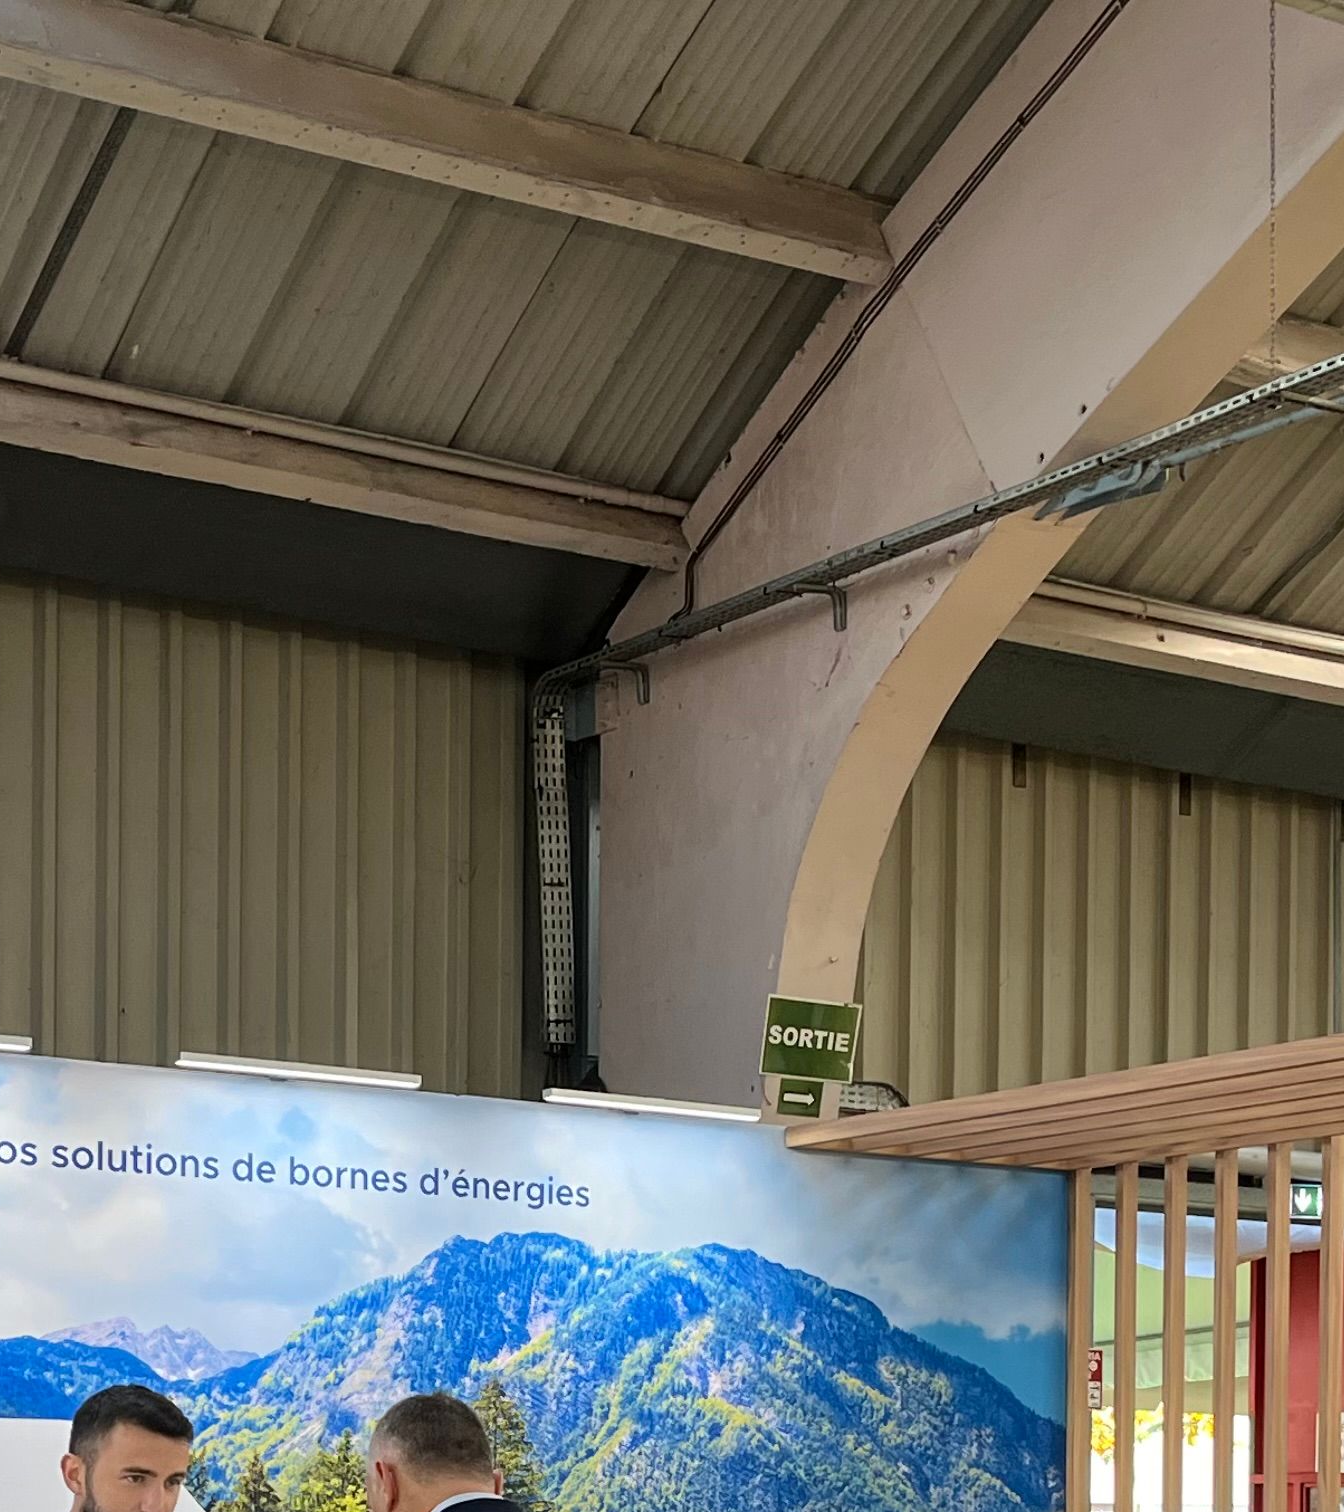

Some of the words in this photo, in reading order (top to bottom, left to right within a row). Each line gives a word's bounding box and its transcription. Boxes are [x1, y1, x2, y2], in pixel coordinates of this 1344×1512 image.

[768, 1025, 850, 1052] SORTIE
[51, 1140, 219, 1179] solutions
[232, 1152, 276, 1183] de
[290, 1156, 407, 1194] bornes
[419, 1167, 590, 1209] d'énergies
